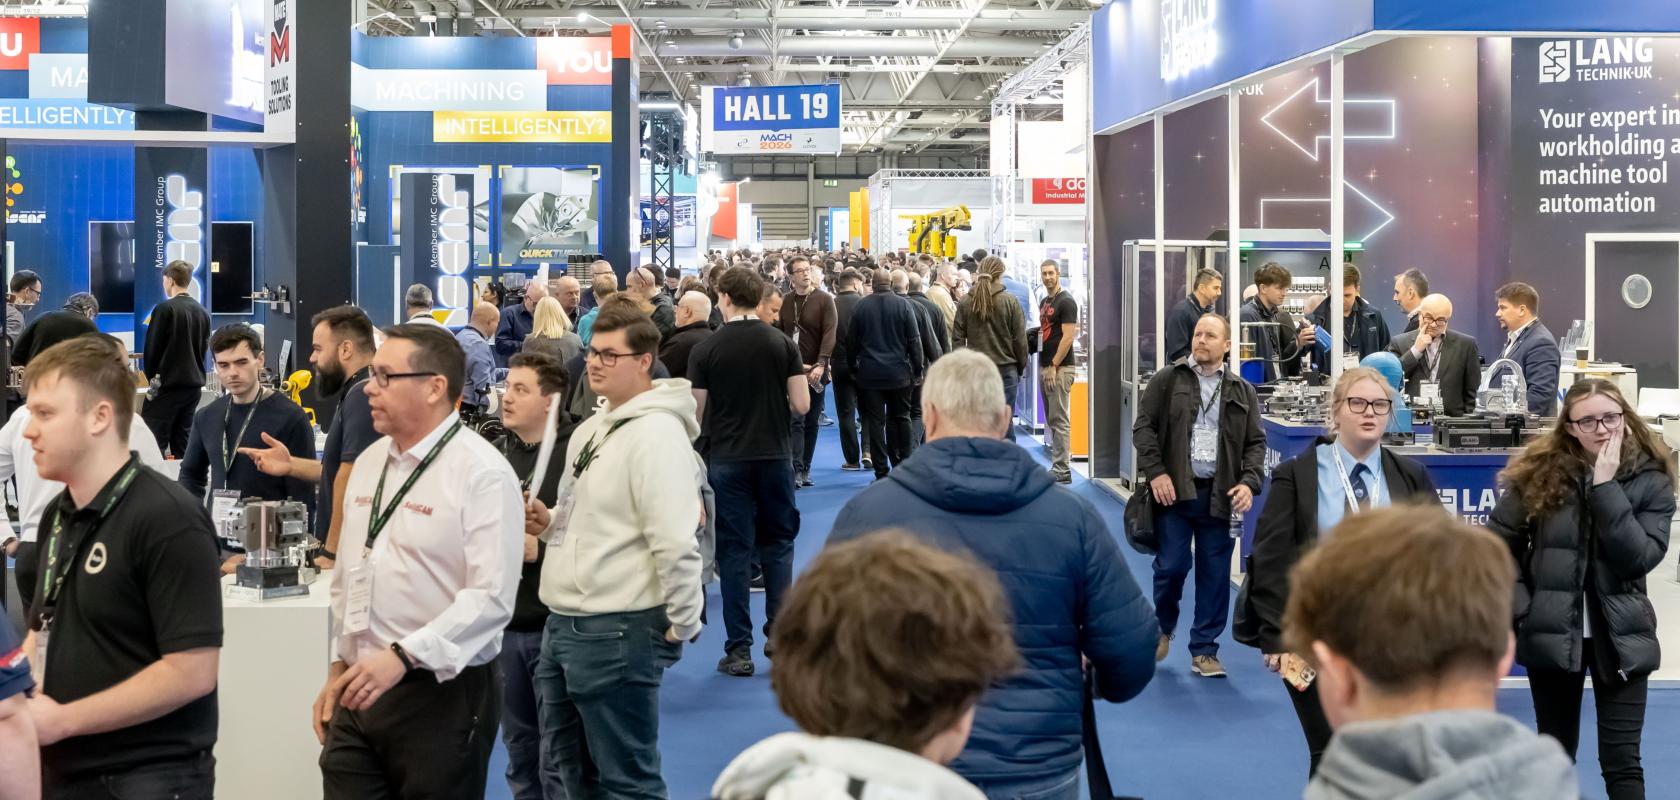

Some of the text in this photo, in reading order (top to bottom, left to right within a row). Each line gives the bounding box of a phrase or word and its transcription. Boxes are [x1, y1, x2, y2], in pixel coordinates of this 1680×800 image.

[553, 51, 612, 73] YOU
[1576, 38, 1653, 65] LANG
[271, 76, 288, 96] TOOLING
[376, 82, 524, 100] MACHINING
[269, 94, 291, 115] SOLUTIONS
[725, 93, 828, 121] HALL 19
[445, 118, 606, 135] INTELLIGENTLY?
[1540, 104, 1680, 132] Your expert in
[1540, 133, 1664, 160] workholding
[1540, 161, 1667, 184] machine tool
[1540, 191, 1655, 213] automation
[155, 177, 167, 268] Member IMC Group
[430, 174, 440, 268] Member IMC Group
[1463, 489, 1505, 511] LA
